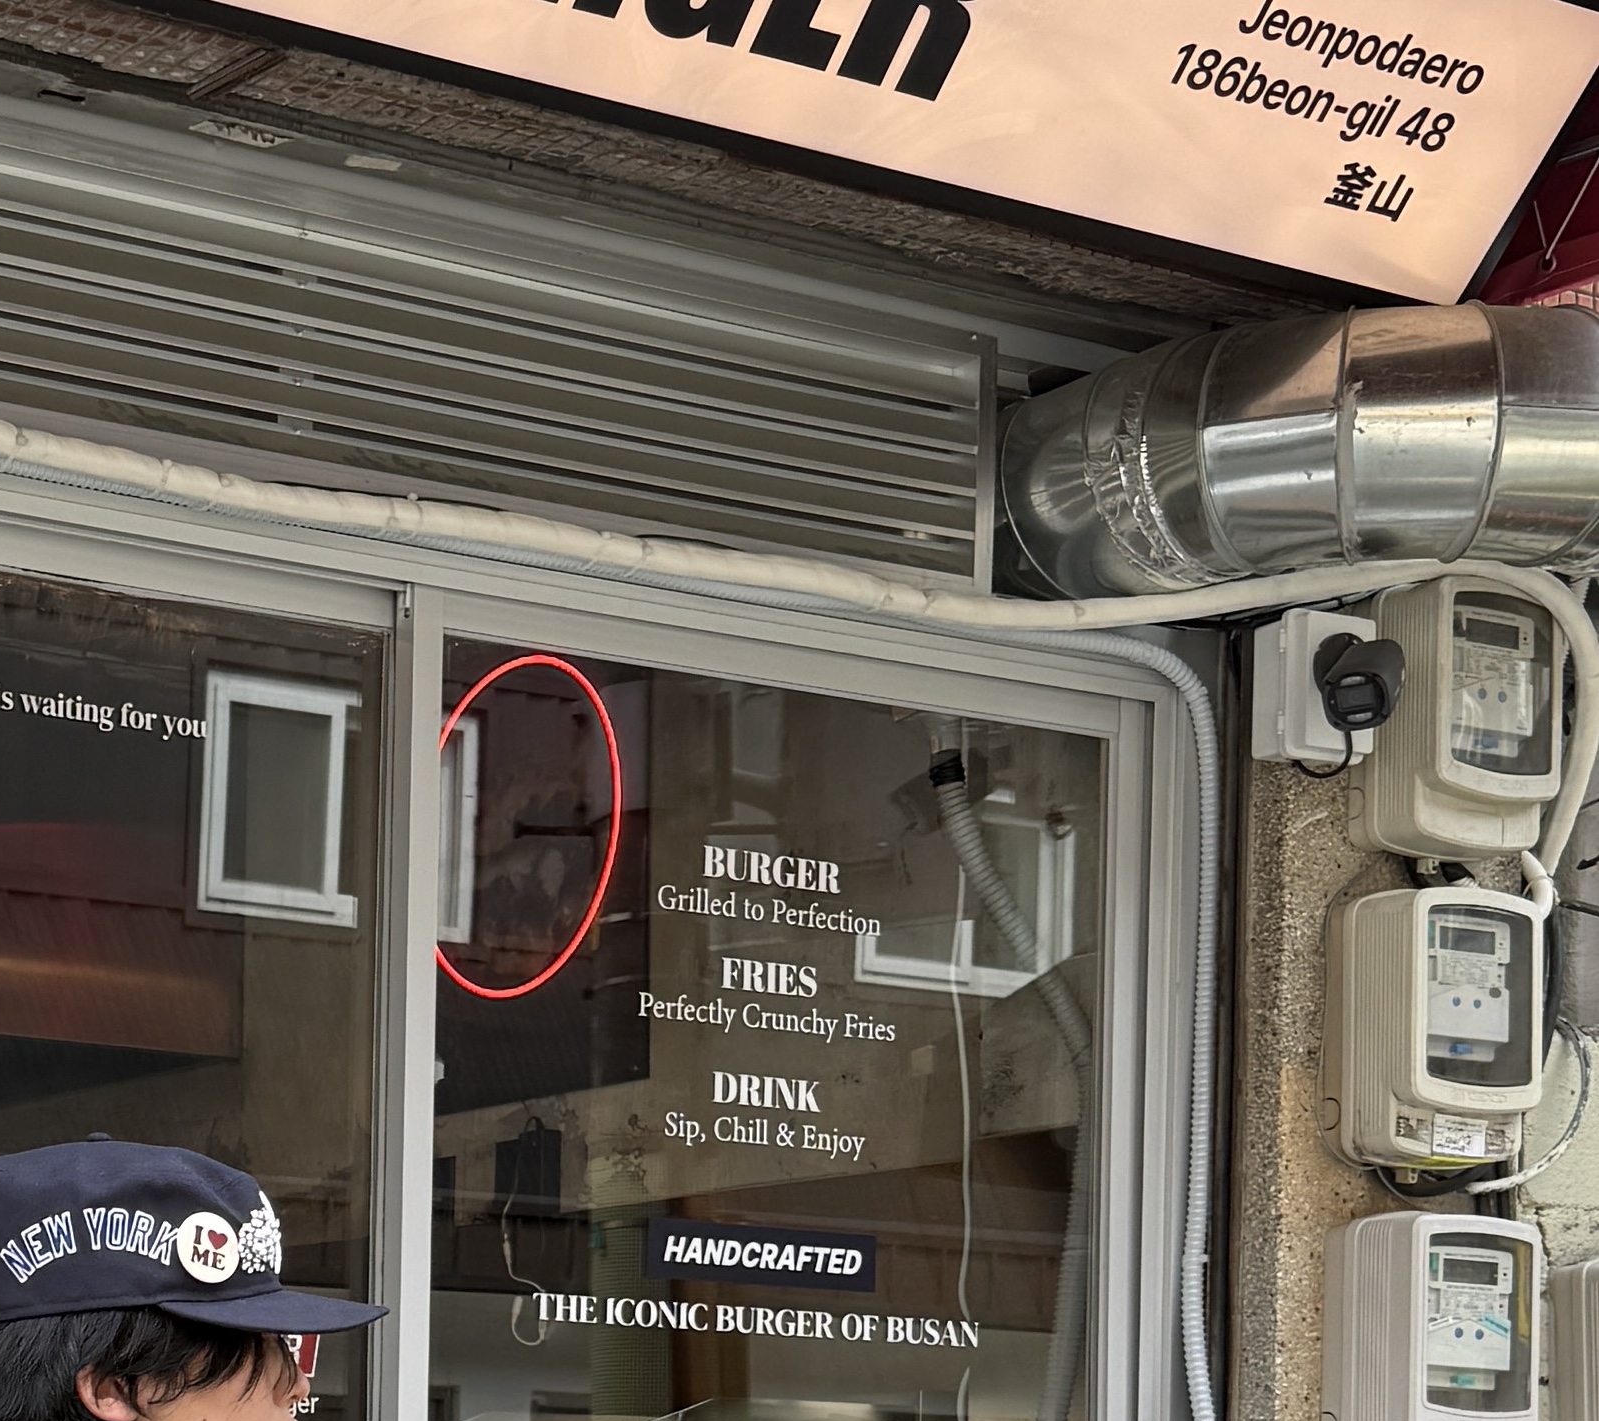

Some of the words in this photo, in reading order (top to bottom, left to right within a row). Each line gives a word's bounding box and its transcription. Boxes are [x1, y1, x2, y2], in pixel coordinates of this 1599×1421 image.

[1239, 0, 1484, 95] Jeonpodaero
[1170, 43, 1401, 142] 186beon-gil
[1396, 106, 1455, 152] 48
[1324, 162, 1414, 222] 釜山
[20, 692, 115, 732] waiting
[120, 702, 157, 732] for
[163, 712, 207, 740] you
[703, 844, 841, 894] BURGER
[657, 885, 737, 918] Grilled
[743, 898, 765, 921] to
[771, 898, 881, 937] Perfection
[721, 956, 818, 998] FRIES
[637, 991, 737, 1034] Perfectly
[742, 1003, 839, 1043] Crunchy
[844, 1013, 896, 1042] Fries
[712, 1070, 821, 1113] DRINK
[664, 1111, 707, 1146] Sip,
[714, 1116, 769, 1145] Chill
[776, 1123, 794, 1147] &
[802, 1125, 866, 1161] Enjoy
[0, 1205, 77, 1283] NEW
[83, 1207, 181, 1267] YORK
[189, 1246, 225, 1272] ME
[194, 1225, 202, 1246] I
[663, 1234, 863, 1275] HANDCRAFTED
[532, 1291, 598, 1324] THE
[605, 1297, 709, 1332] ICONIC
[716, 1304, 834, 1339] BURGER
[841, 1312, 879, 1343] OF
[886, 1317, 980, 1349] BUSAN
